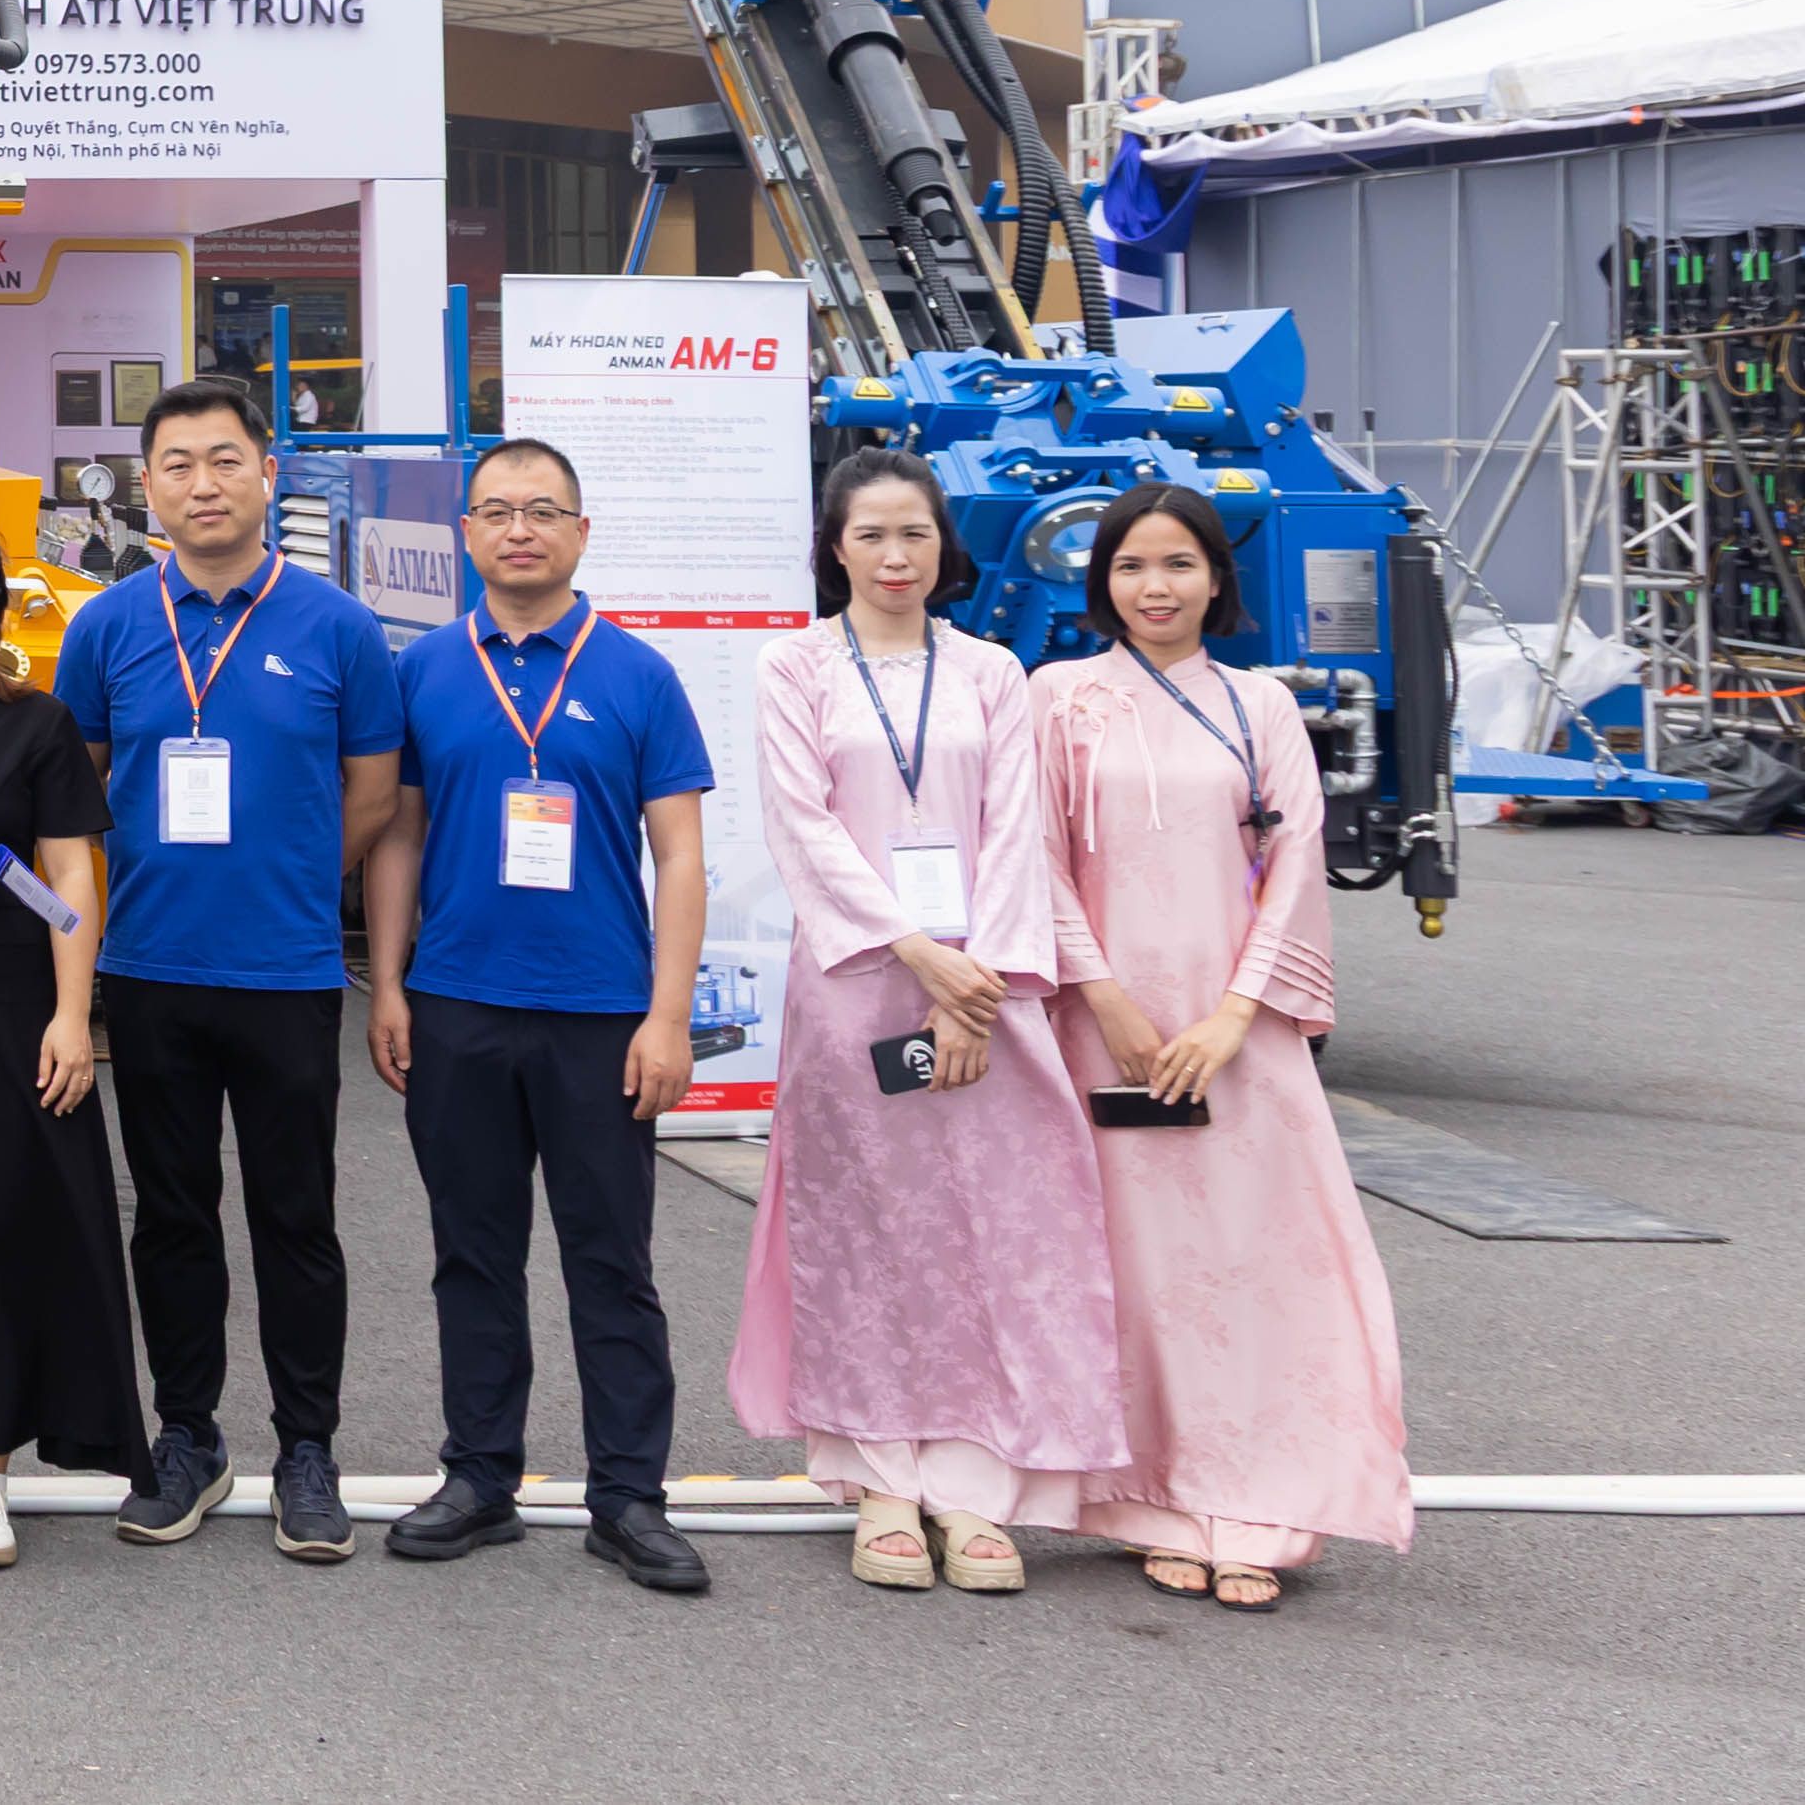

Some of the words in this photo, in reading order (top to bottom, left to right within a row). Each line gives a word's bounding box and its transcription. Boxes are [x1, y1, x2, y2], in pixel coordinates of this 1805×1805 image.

[35, 54, 201, 74] 0979.573.000
[11, 120, 61, 138] Quyết
[66, 120, 122, 137] Thắng,
[128, 120, 167, 138] Cụm
[171, 120, 194, 134] CN
[200, 119, 230, 134] Yên
[235, 119, 290, 138] Nghĩa,
[34, 143, 66, 161] Nội,
[71, 143, 123, 158] Thành
[129, 142, 161, 162] phố
[165, 143, 187, 158] Hà
[192, 142, 221, 161] Nội
[530, 330, 565, 348] MÁY
[570, 335, 628, 348] KHOAN
[633, 336, 664, 348] NEO
[608, 356, 665, 369] ANMAN
[670, 337, 779, 371] AM-6
[387, 546, 453, 598] ANMAN
